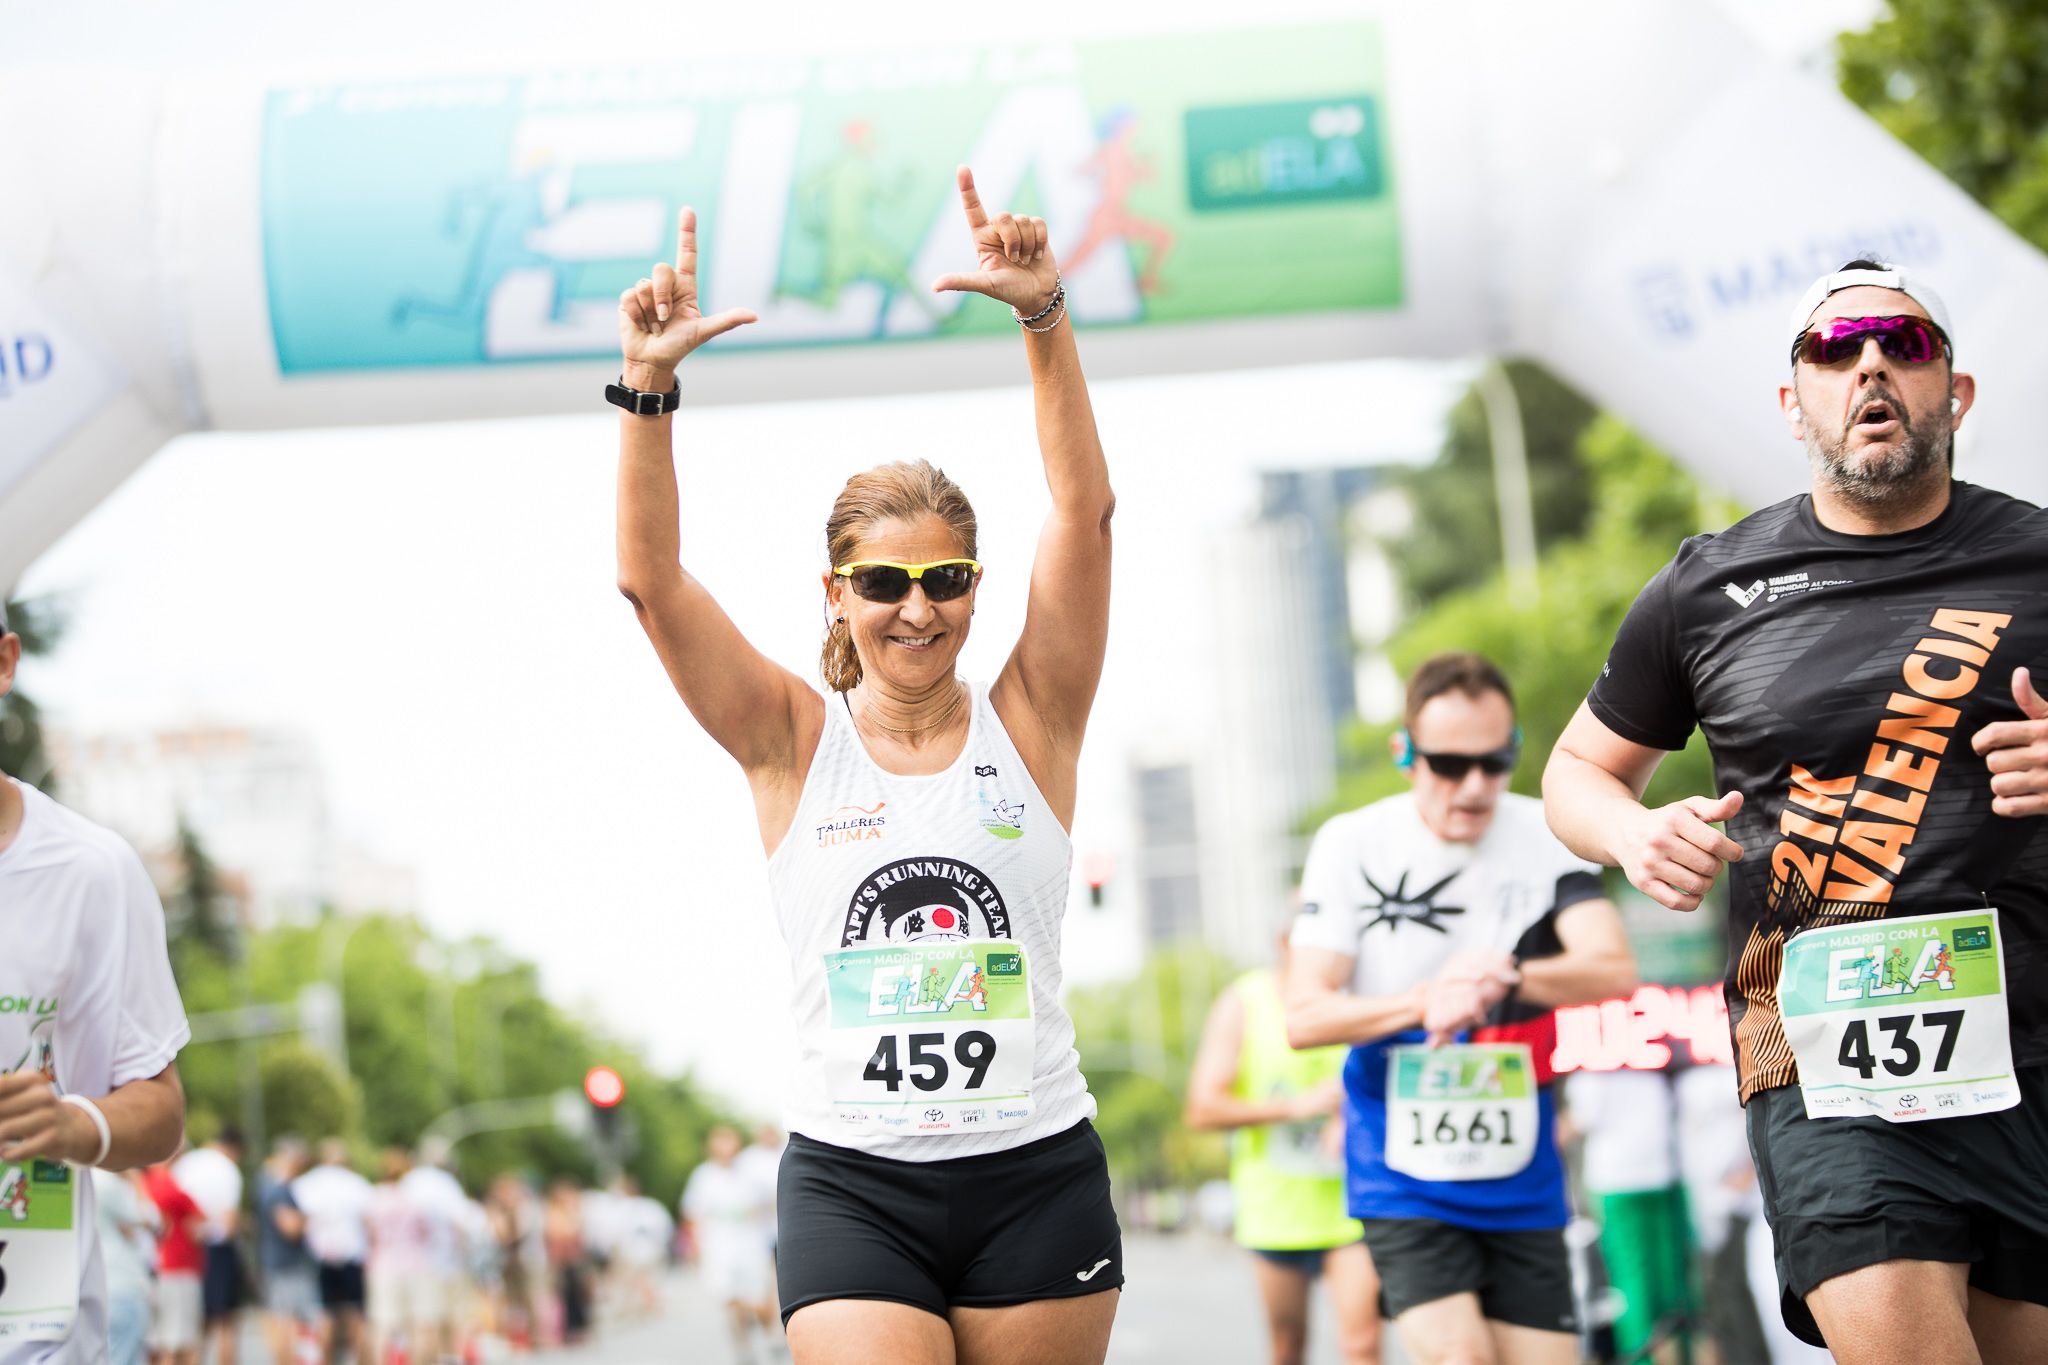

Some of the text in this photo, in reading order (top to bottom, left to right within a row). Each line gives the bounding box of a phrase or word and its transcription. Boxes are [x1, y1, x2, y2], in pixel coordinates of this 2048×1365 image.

[484, 88, 1141, 360] ELA
[1768, 572, 1809, 586] VALENCIA
[1769, 582, 1809, 594] TRINIDAD
[1744, 584, 1762, 601] 21K
[1823, 607, 2013, 904] VALENCIA
[816, 816, 886, 841] TALLERES
[818, 827, 882, 849] JUMA
[1770, 763, 1857, 900] 21K
[873, 861, 982, 892] RUNNING
[1829, 931, 1885, 948] MADRID
[1888, 929, 1919, 942] CON
[1921, 926, 1939, 938] LA
[874, 951, 925, 965] MADRID
[926, 949, 957, 960] CON
[958, 948, 976, 960] LA
[1825, 938, 1956, 1003] ELA
[867, 961, 988, 1017] ELA
[1838, 1010, 1966, 1079] 437
[863, 1030, 997, 1092] 459
[1003, 1109, 1028, 1118] MADRID
[1938, 1099, 1955, 1107] LIFE
[963, 1115, 979, 1123] LIFE
[1411, 1108, 1516, 1147] 1661
